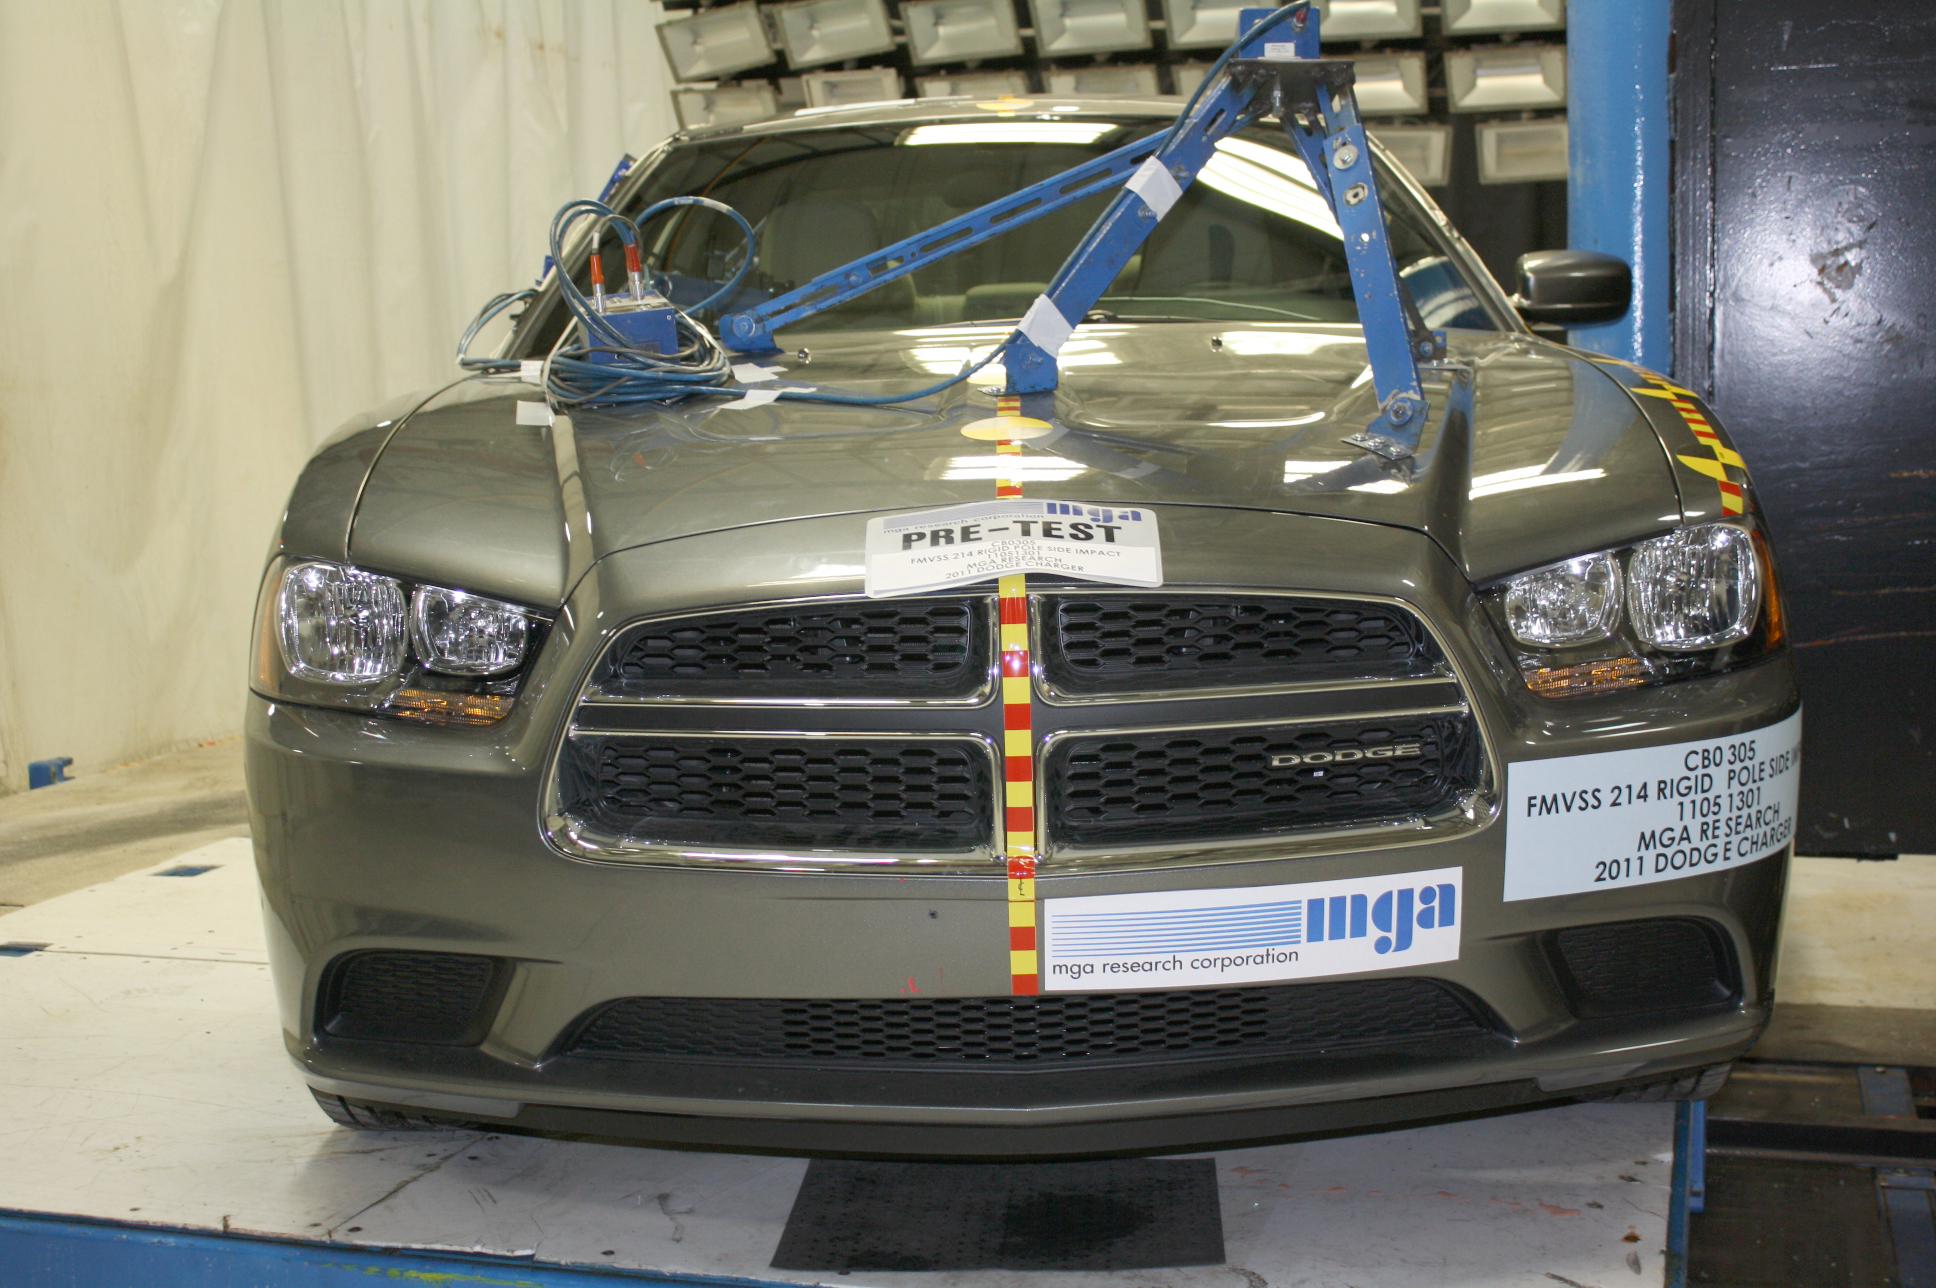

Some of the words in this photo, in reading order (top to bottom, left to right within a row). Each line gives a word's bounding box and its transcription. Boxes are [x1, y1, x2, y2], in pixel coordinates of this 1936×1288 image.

[883, 526, 910, 535] mga
[914, 518, 968, 530] research
[972, 512, 1044, 522] corporation
[1046, 502, 1142, 524] mga
[902, 520, 1122, 551] PRE-TEST
[910, 553, 949, 565] FMVSS
[952, 550, 974, 560] 214
[977, 545, 1010, 557] RIGID
[1013, 544, 1043, 552] POLE
[1046, 545, 1072, 554] SIDE
[1075, 548, 1122, 558] IMPACT
[966, 558, 997, 570] MGA
[1001, 555, 1062, 564] RESEARCH
[988, 549, 1041, 560] 11051301
[945, 569, 972, 580] 2011
[976, 561, 1021, 573] DODGE
[1025, 560, 1085, 572] CHARGER
[1271, 743, 1422, 767] DODGE
[1527, 788, 1602, 818] FMVSS
[1609, 780, 1649, 808] 214
[1656, 773, 1713, 801] RIGID
[1727, 760, 1766, 790] POLE
[1768, 748, 1790, 779] SIDE
[1593, 855, 1644, 883] 2011
[1654, 840, 1732, 874] DODGE
[1736, 815, 1792, 858] CHARGER
[1636, 824, 1692, 853] MGA
[1305, 882, 1456, 956] mga
[1051, 960, 1095, 980] mga
[1102, 954, 1183, 974] research
[1190, 947, 1299, 974] corporation
